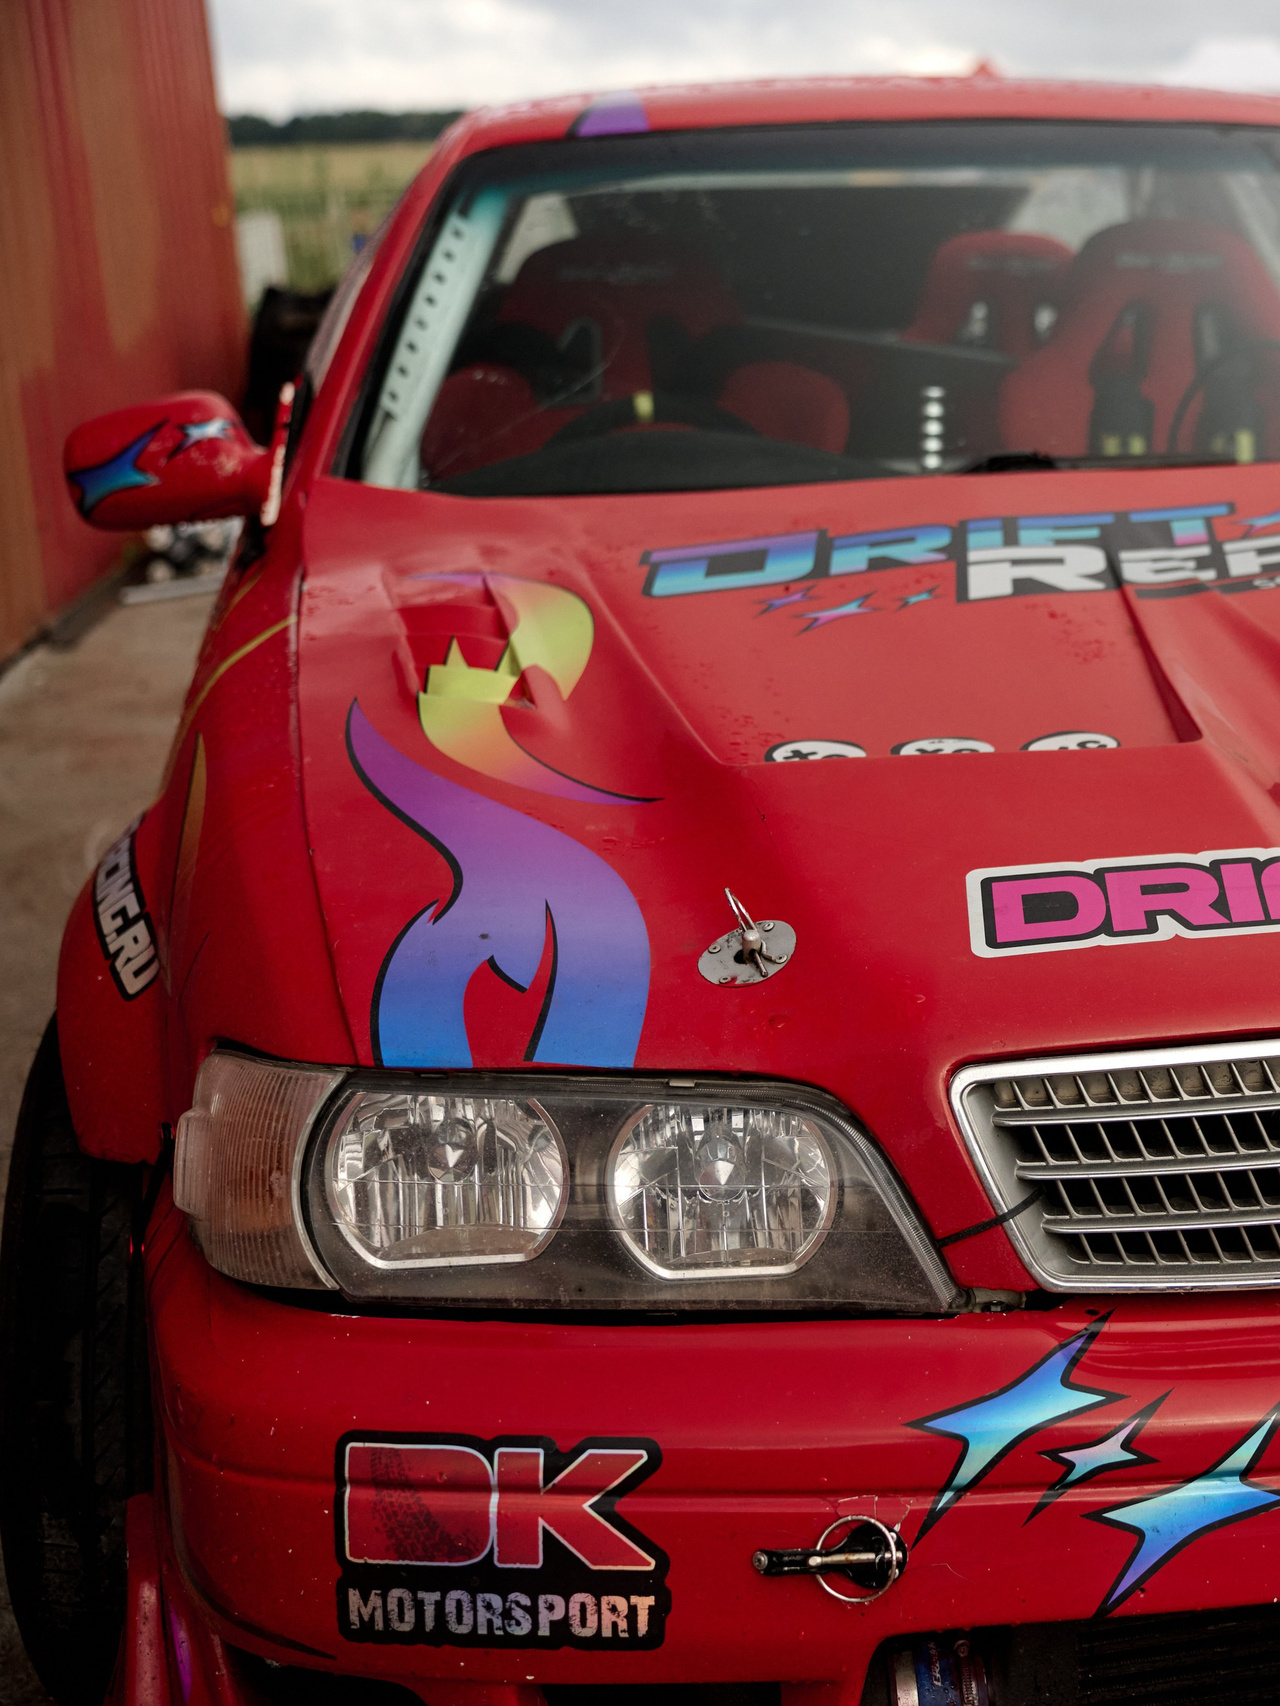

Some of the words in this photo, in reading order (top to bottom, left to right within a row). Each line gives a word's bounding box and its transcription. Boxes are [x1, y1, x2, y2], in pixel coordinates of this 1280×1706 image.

[645, 502, 1234, 598] DRIFT
[344, 1441, 656, 1571] DK
[347, 1587, 656, 1638] MOTORSPORT
